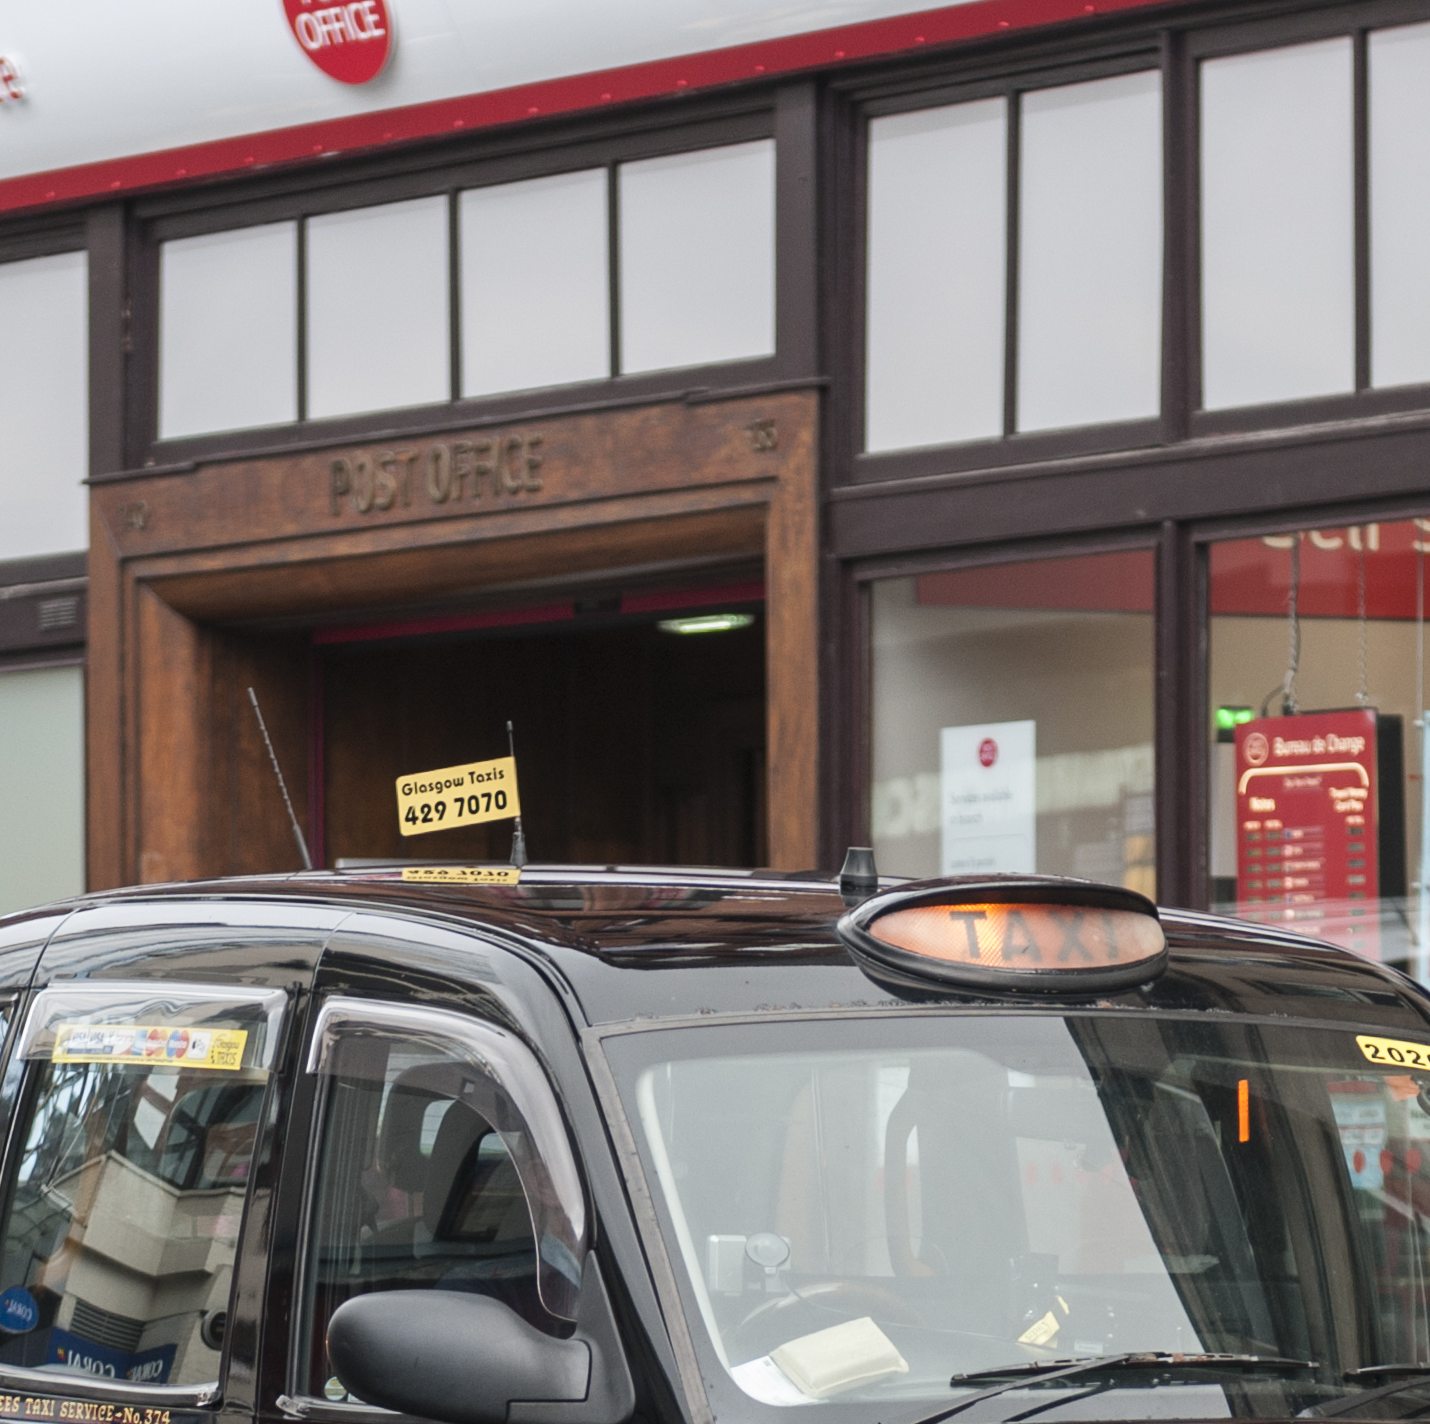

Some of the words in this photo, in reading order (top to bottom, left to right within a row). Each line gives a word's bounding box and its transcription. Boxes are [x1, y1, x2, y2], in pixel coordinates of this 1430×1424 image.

[295, 0, 386, 50] OFFICE
[329, 450, 419, 517] POST
[426, 432, 544, 504] OFFICE
[1273, 736, 1311, 757] Bureau
[1312, 735, 1326, 754] de
[1326, 733, 1366, 756] Change
[402, 776, 464, 796] Glasgow
[468, 767, 505, 784] Taxis
[405, 801, 447, 825] 429
[454, 790, 507, 817] 7070
[950, 911, 1119, 963] TAXI
[25, 1398, 54, 1417] TAXI
[59, 1401, 114, 1423] SERVICE
